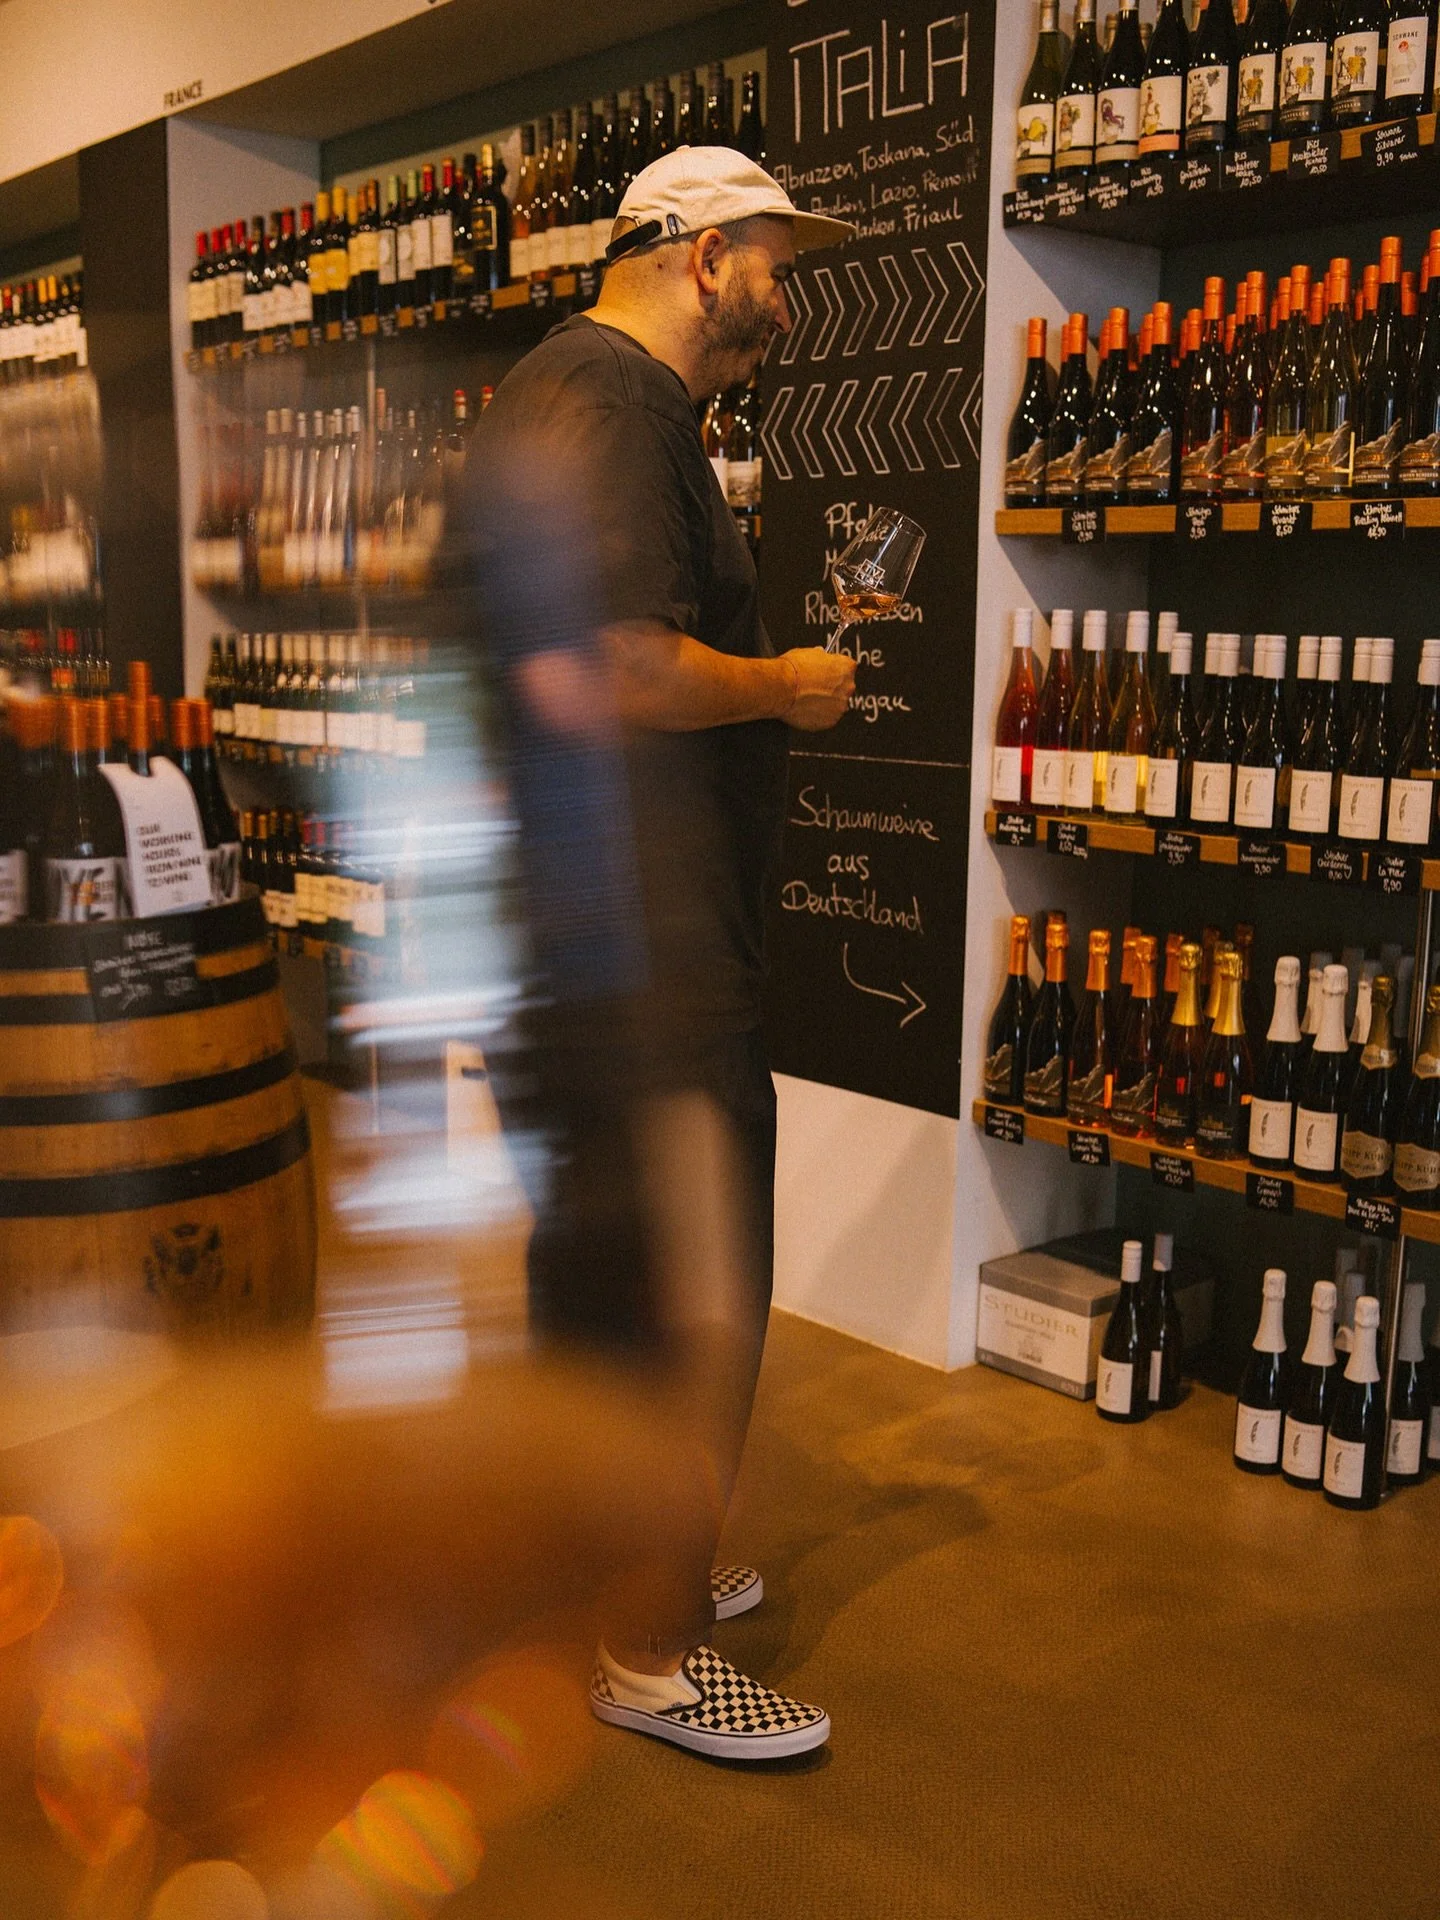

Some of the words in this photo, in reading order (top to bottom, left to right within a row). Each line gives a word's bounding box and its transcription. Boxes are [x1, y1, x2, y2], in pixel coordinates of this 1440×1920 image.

[1393, 31, 1418, 41] SCHWANE
[163, 79, 203, 107] FRANCE
[936, 114, 974, 152] Süd
[1309, 164, 1328, 174] 10,50
[1377, 152, 1394, 167] 9,90
[1240, 175, 1262, 188] 10,50
[903, 198, 963, 232] Friaul
[847, 693, 911, 722] ingau
[790, 785, 940, 841] Schaumweine
[827, 854, 869, 880] aus
[782, 881, 924, 934] Deutschland
[985, 1293, 1079, 1337] STUDIER
